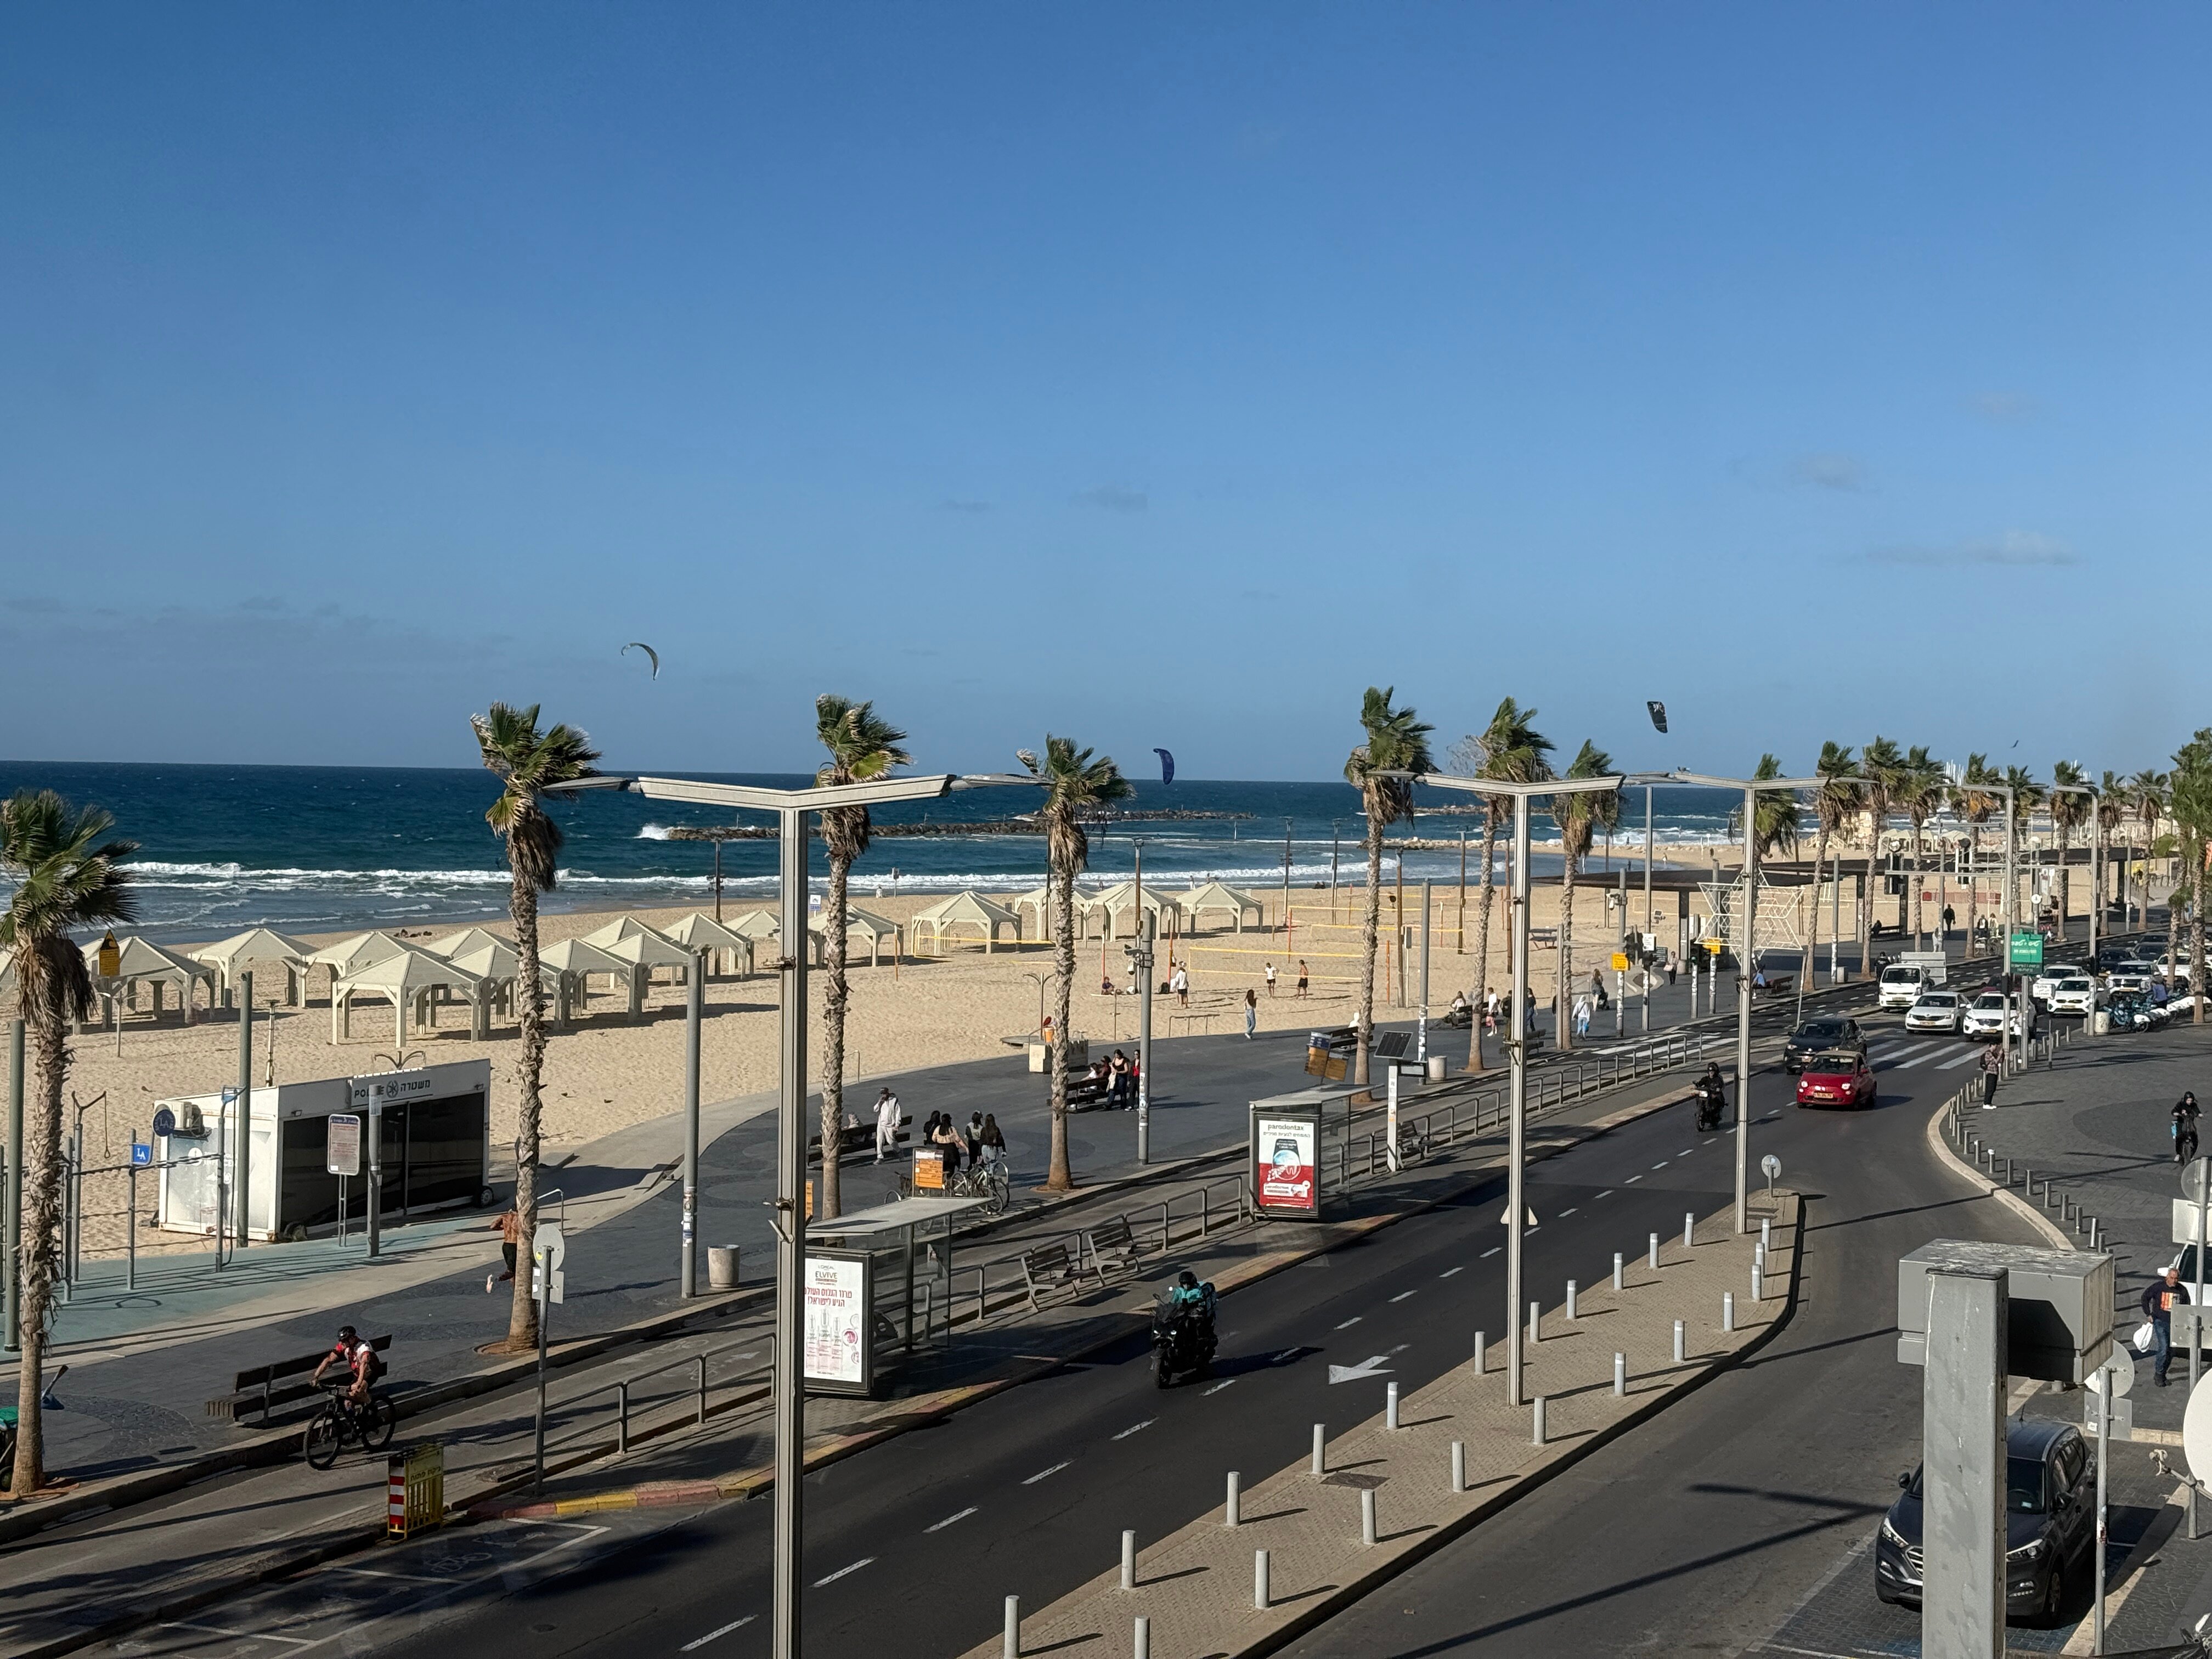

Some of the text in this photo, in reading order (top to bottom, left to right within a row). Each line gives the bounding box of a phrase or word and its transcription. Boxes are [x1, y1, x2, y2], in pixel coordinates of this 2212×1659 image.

[354, 1086, 385, 1098] POLE
[400, 1080, 431, 1092] משטרה
[137, 1148, 146, 1160] LA
[815, 1271, 838, 1279] ELVIVE
[832, 1299, 845, 1307] הגיע
